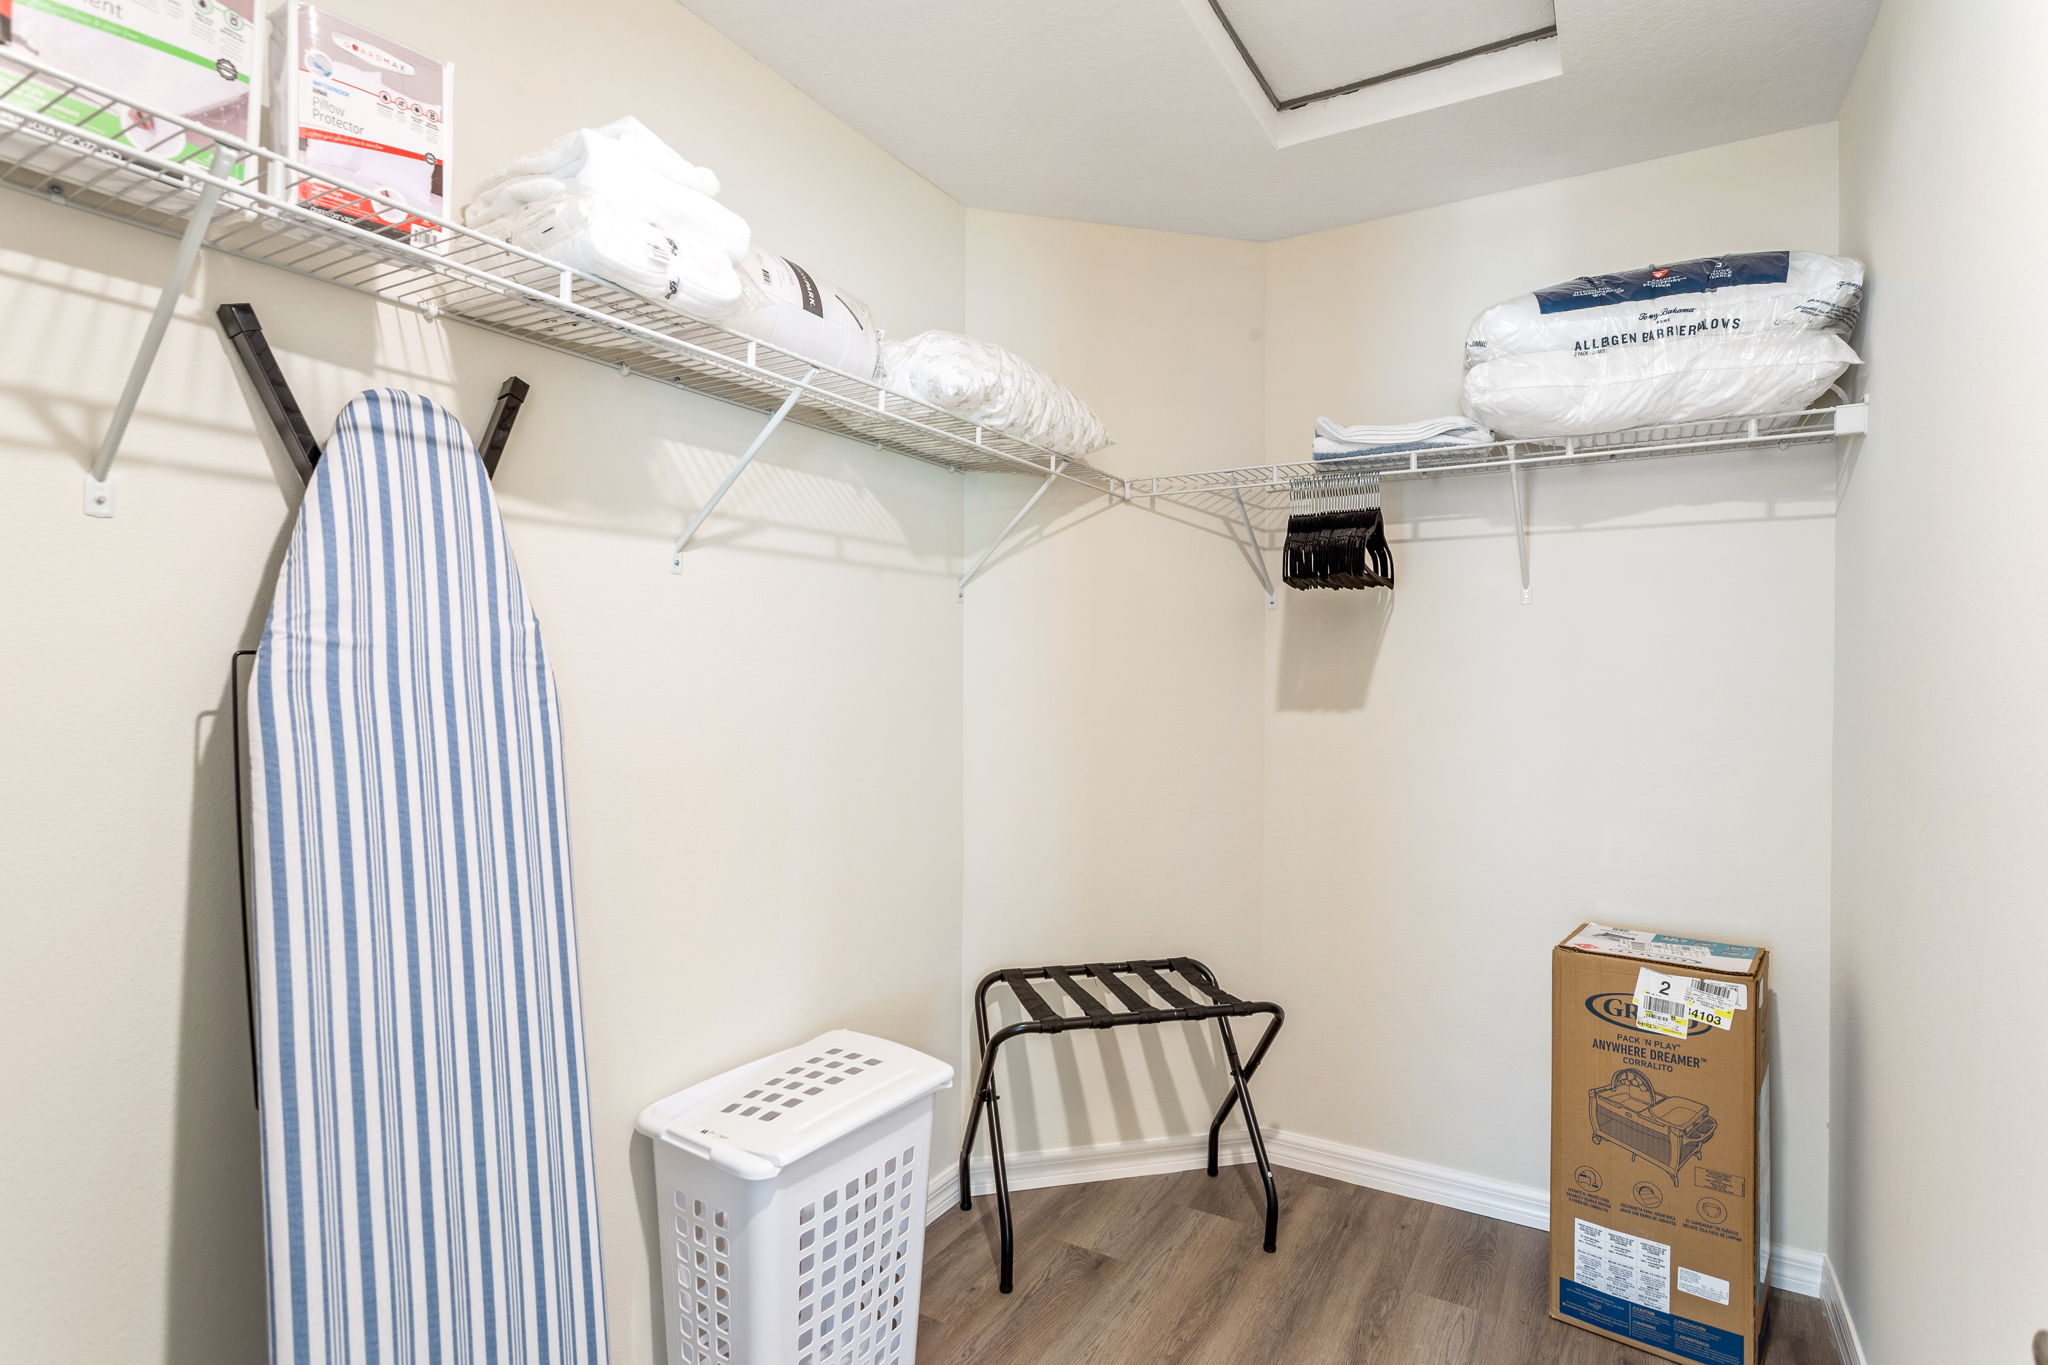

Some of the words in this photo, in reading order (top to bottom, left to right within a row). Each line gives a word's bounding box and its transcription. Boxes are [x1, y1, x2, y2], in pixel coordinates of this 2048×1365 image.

[84, 0, 123, 20] ent
[312, 96, 346, 117] Pillow
[312, 107, 365, 136] Protector
[1659, 307, 1696, 317] Bahama
[1658, 980, 1671, 996] 2
[1616, 1033, 1640, 1044] PACK
[1592, 1038, 1647, 1059] ANYWHERE
[1623, 1058, 1674, 1073] CORRALITO
